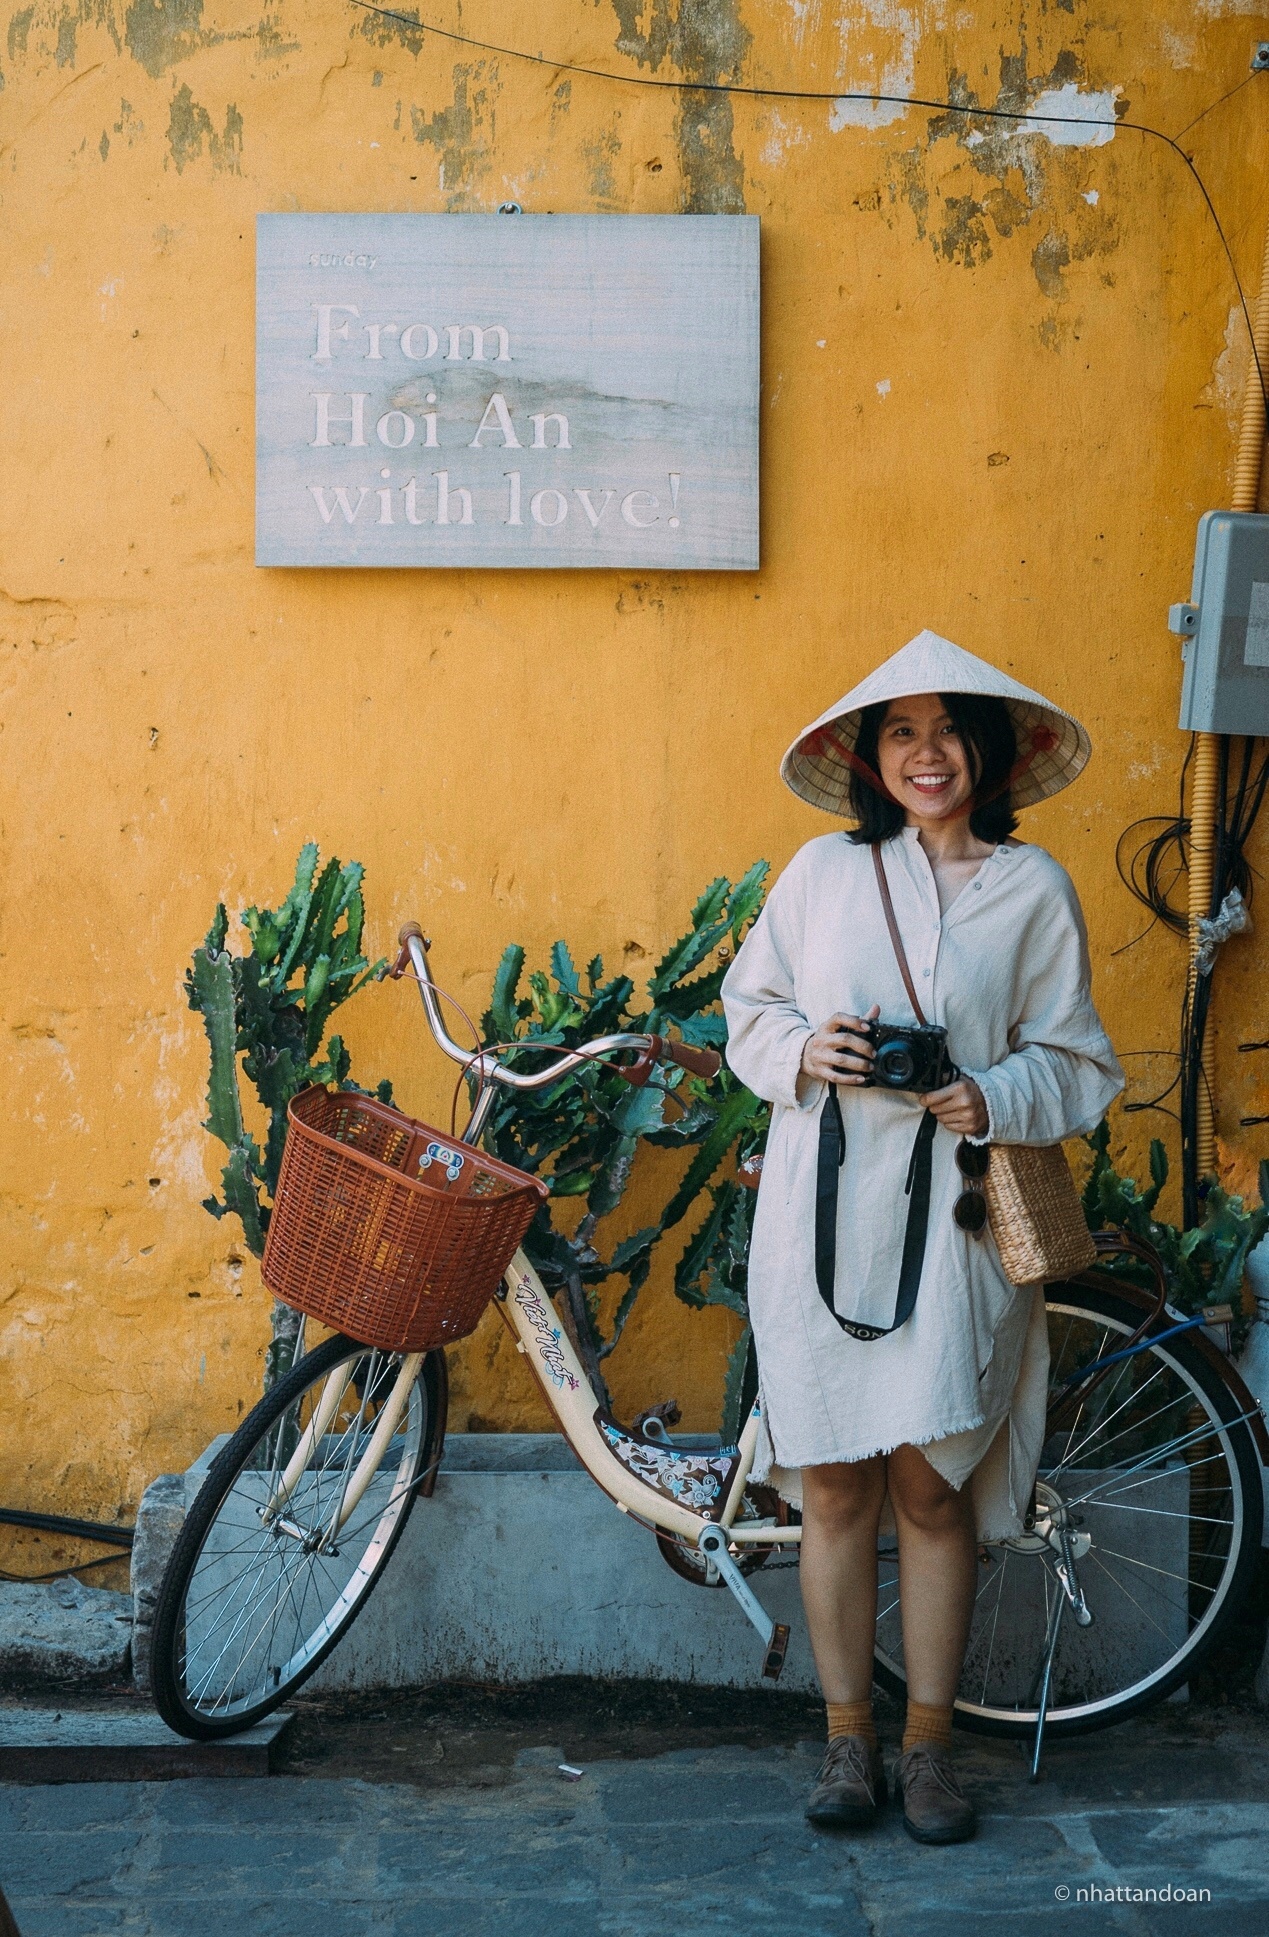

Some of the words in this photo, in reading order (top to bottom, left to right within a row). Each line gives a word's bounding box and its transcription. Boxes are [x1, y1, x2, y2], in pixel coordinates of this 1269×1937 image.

[308, 249, 378, 270] sunday
[309, 302, 514, 361] From
[307, 391, 441, 449] Hoi
[468, 391, 573, 449] An
[306, 467, 475, 526] with
[503, 470, 681, 528] love!
